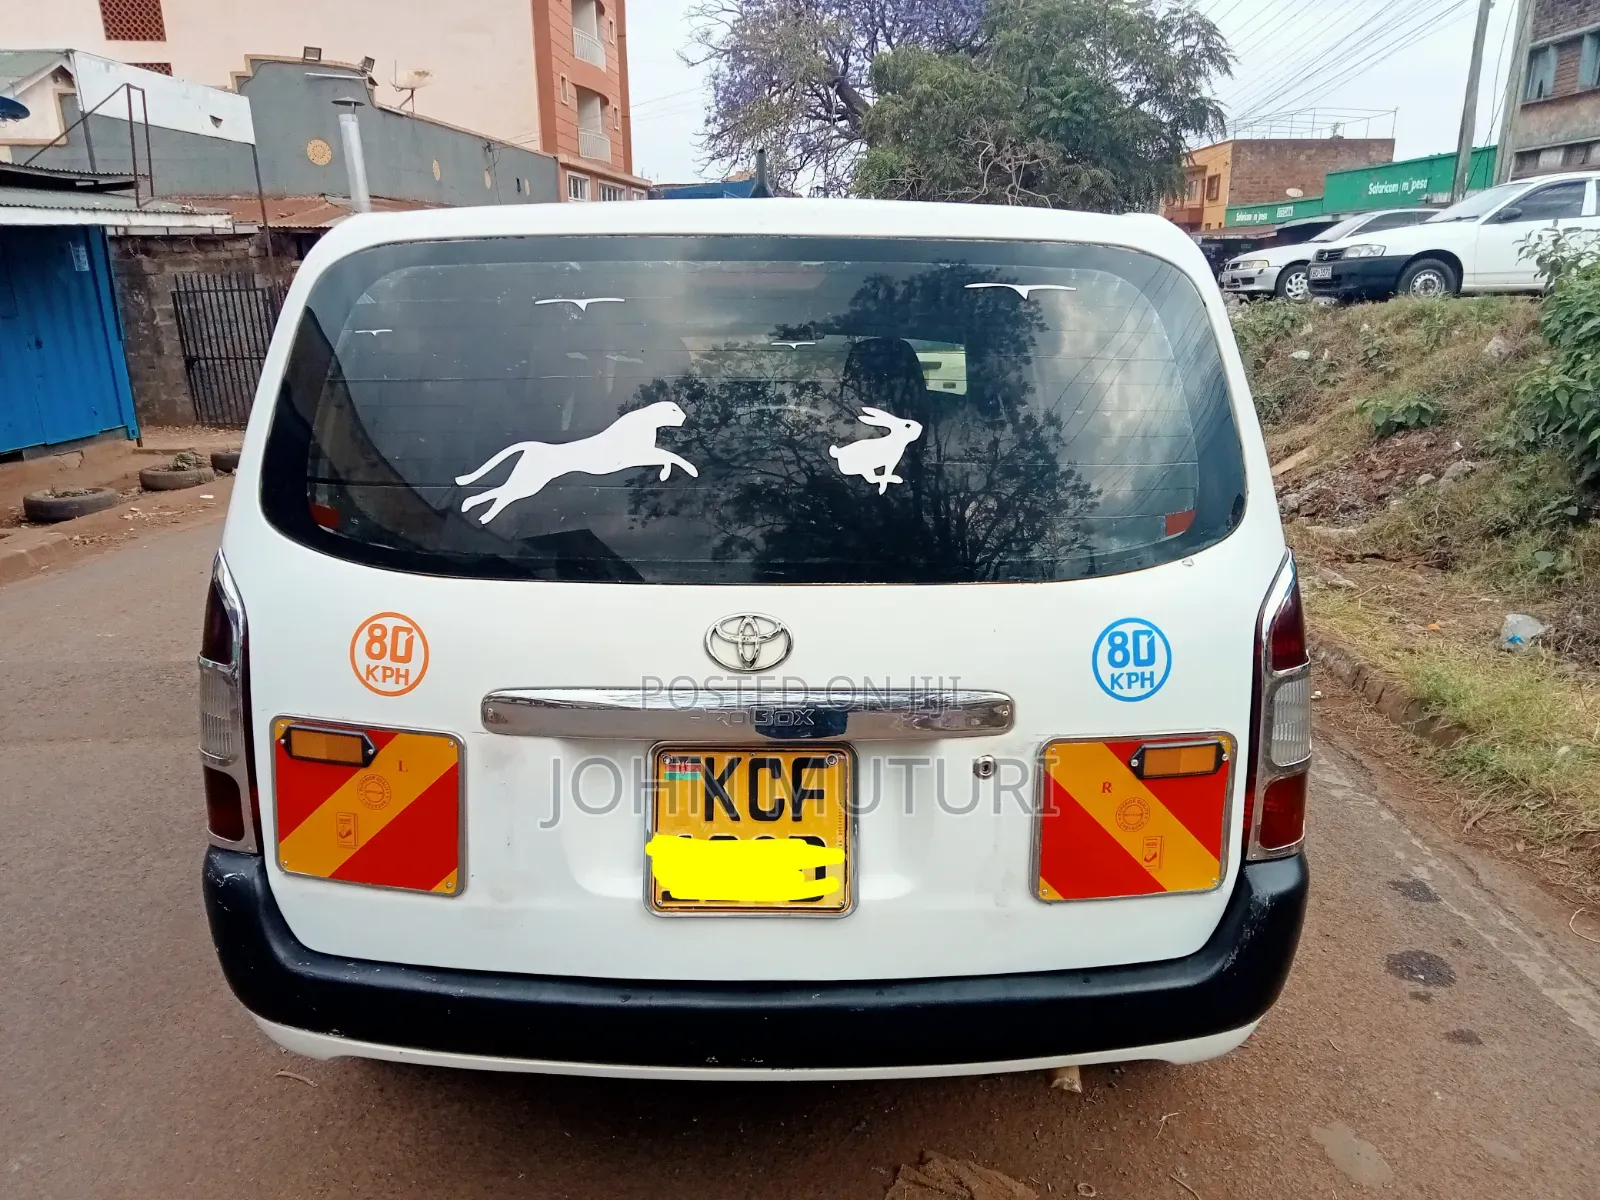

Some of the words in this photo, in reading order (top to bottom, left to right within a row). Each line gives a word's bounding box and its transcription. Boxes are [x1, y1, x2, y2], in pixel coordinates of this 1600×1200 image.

[1368, 181, 1399, 195] Safaricom
[365, 623, 414, 664] 80
[1107, 629, 1156, 669] 80
[365, 664, 410, 686] KPH
[1110, 671, 1155, 690] KPH
[704, 757, 830, 822] KCF
[1101, 781, 1113, 794] R
